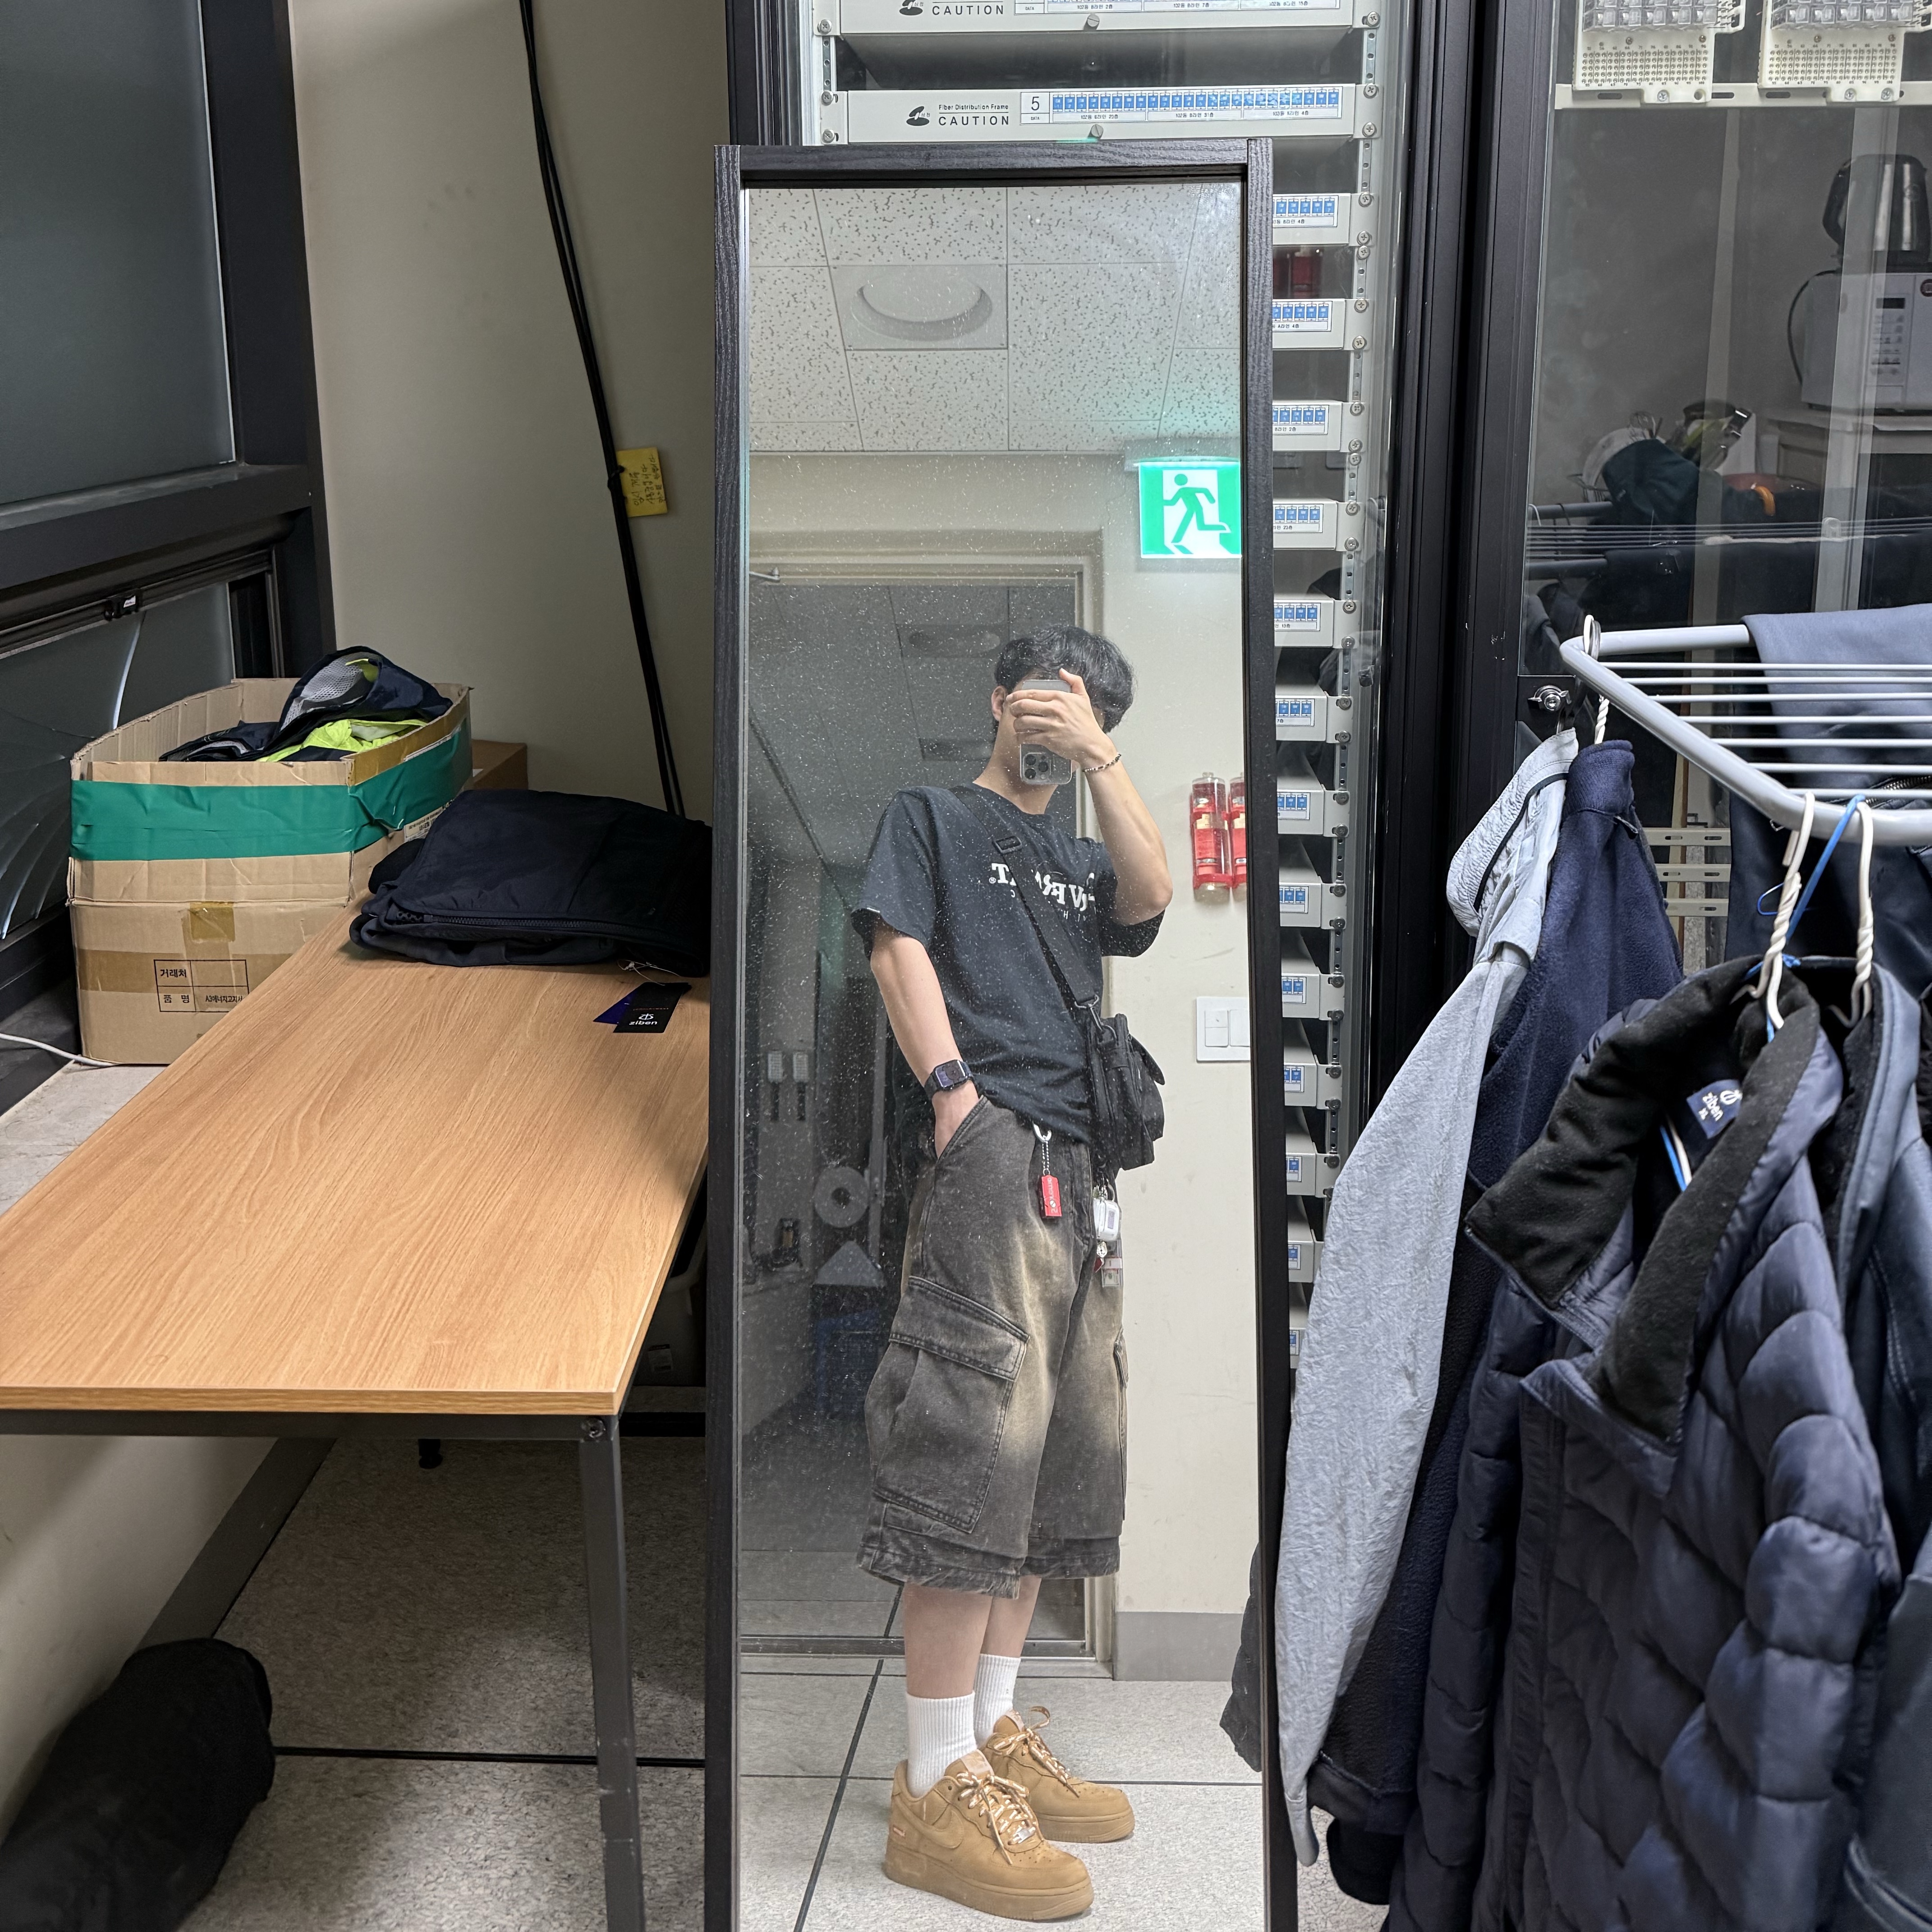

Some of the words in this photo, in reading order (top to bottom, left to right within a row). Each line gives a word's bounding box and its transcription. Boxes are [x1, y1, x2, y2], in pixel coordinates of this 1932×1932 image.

[932, 5, 1004, 15] CAUTION
[1031, 96, 1040, 111] 5
[938, 116, 1009, 125] CAUTION
[160, 969, 187, 978] 거래처
[1702, 1091, 1723, 1122] ziben
